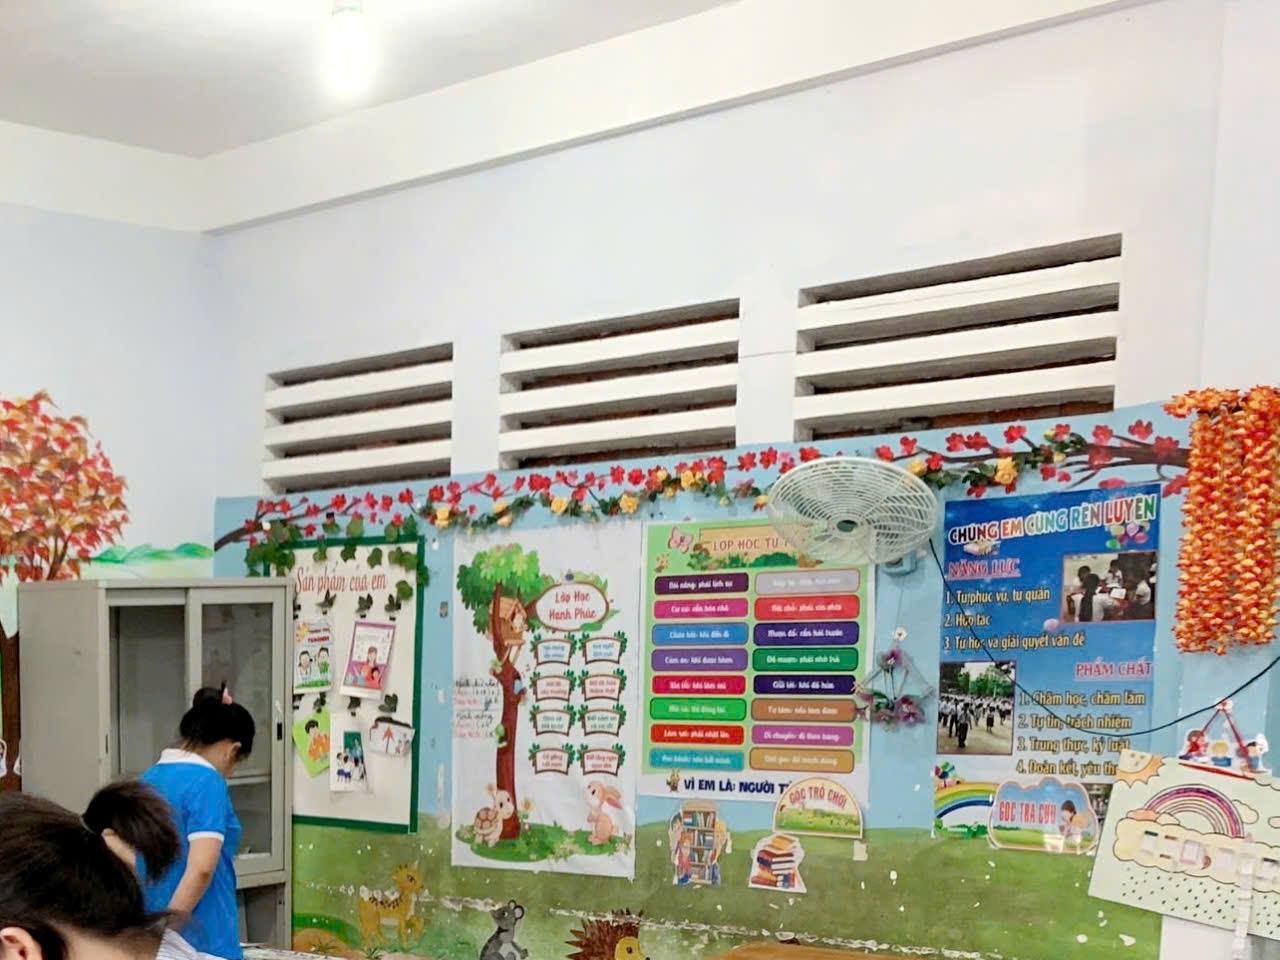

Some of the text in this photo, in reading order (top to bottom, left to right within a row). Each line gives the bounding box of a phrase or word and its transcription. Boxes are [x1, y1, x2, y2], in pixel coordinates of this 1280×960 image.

[1000, 516, 1024, 538] EM
[371, 574, 387, 590] em
[1018, 714, 1029, 729] 2.
[1029, 737, 1059, 754] Trung
[1016, 759, 1027, 774] 4.
[698, 779, 716, 792] EM
[1020, 802, 1036, 823] TRA
